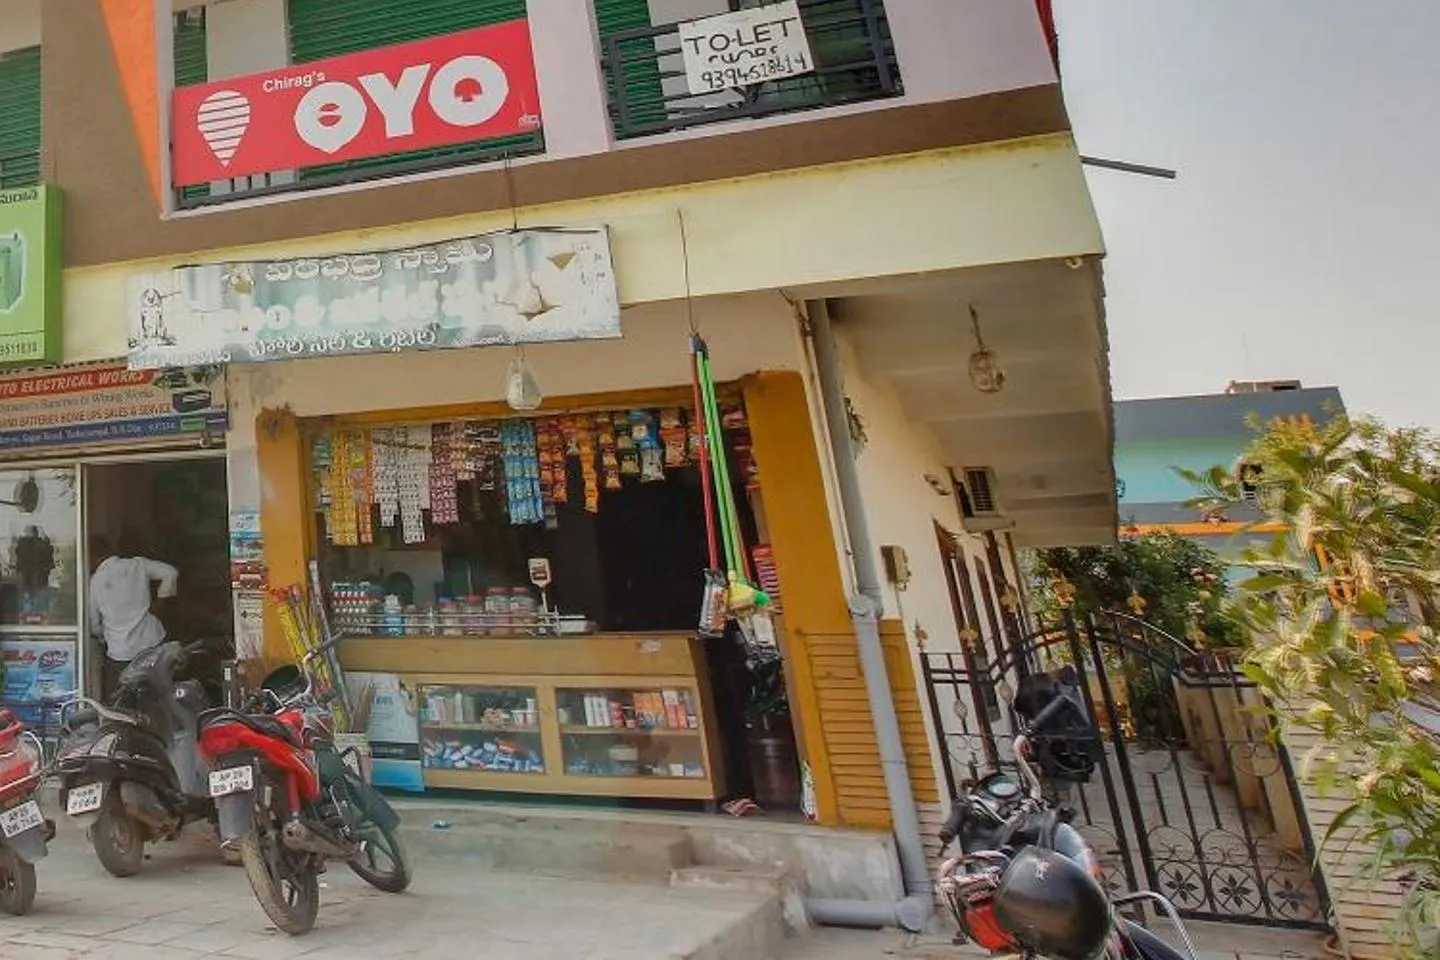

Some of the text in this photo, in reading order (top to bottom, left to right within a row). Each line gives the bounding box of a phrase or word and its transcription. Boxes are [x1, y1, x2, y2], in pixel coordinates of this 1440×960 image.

[262, 69, 326, 94] Chirag's
[293, 54, 510, 155] OYO
[20, 373, 93, 393] ELECTRICAL
